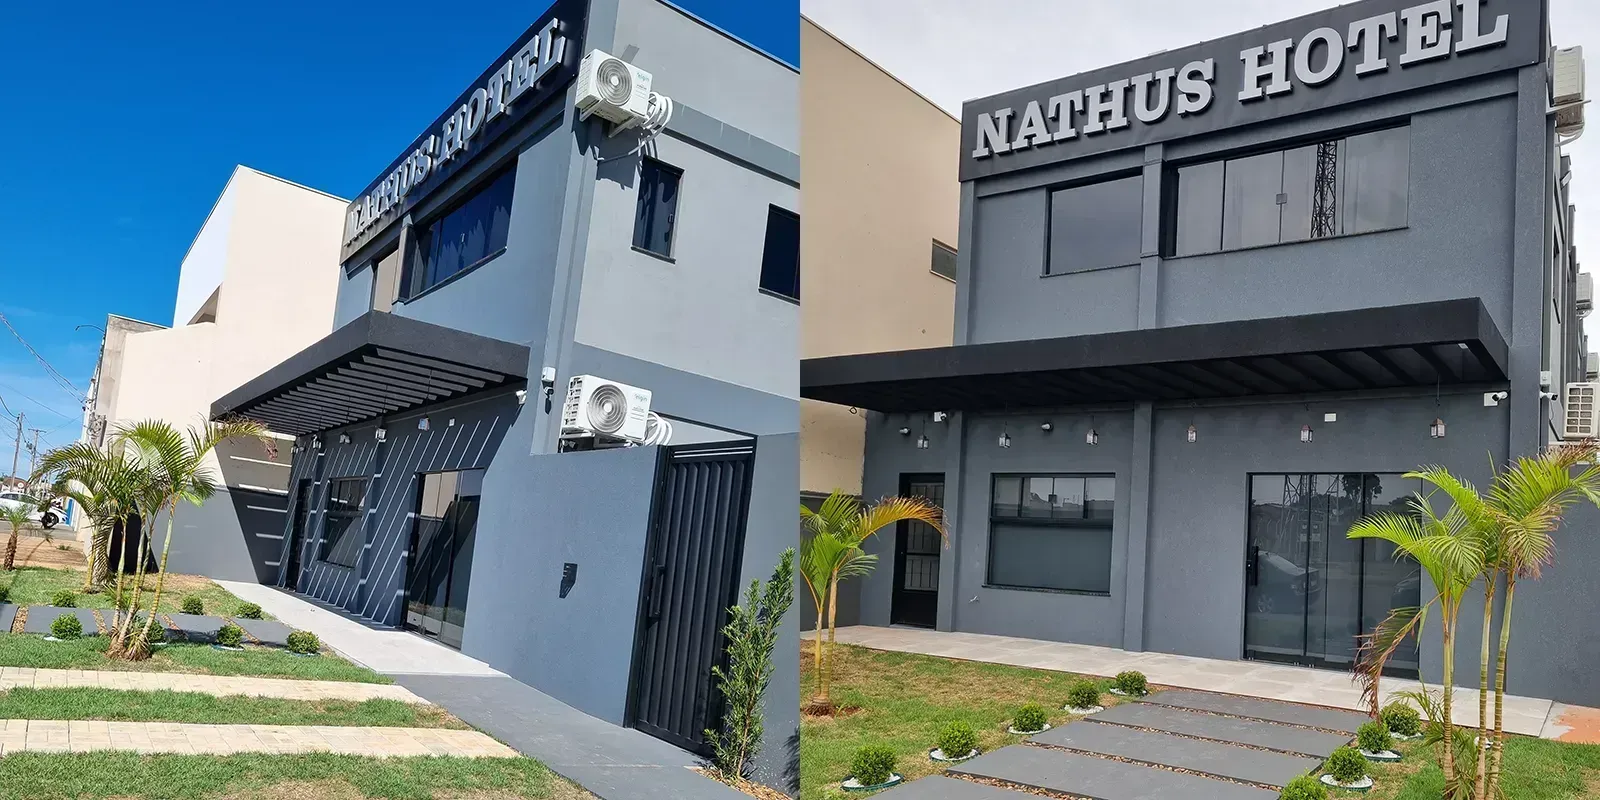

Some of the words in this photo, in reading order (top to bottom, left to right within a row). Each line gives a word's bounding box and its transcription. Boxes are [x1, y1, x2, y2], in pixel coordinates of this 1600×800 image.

[344, 134, 434, 246] NATHUS
[437, 18, 566, 166] HOTEL
[972, 59, 1215, 158] NATHUS
[1238, 0, 1509, 102] HOTEL
